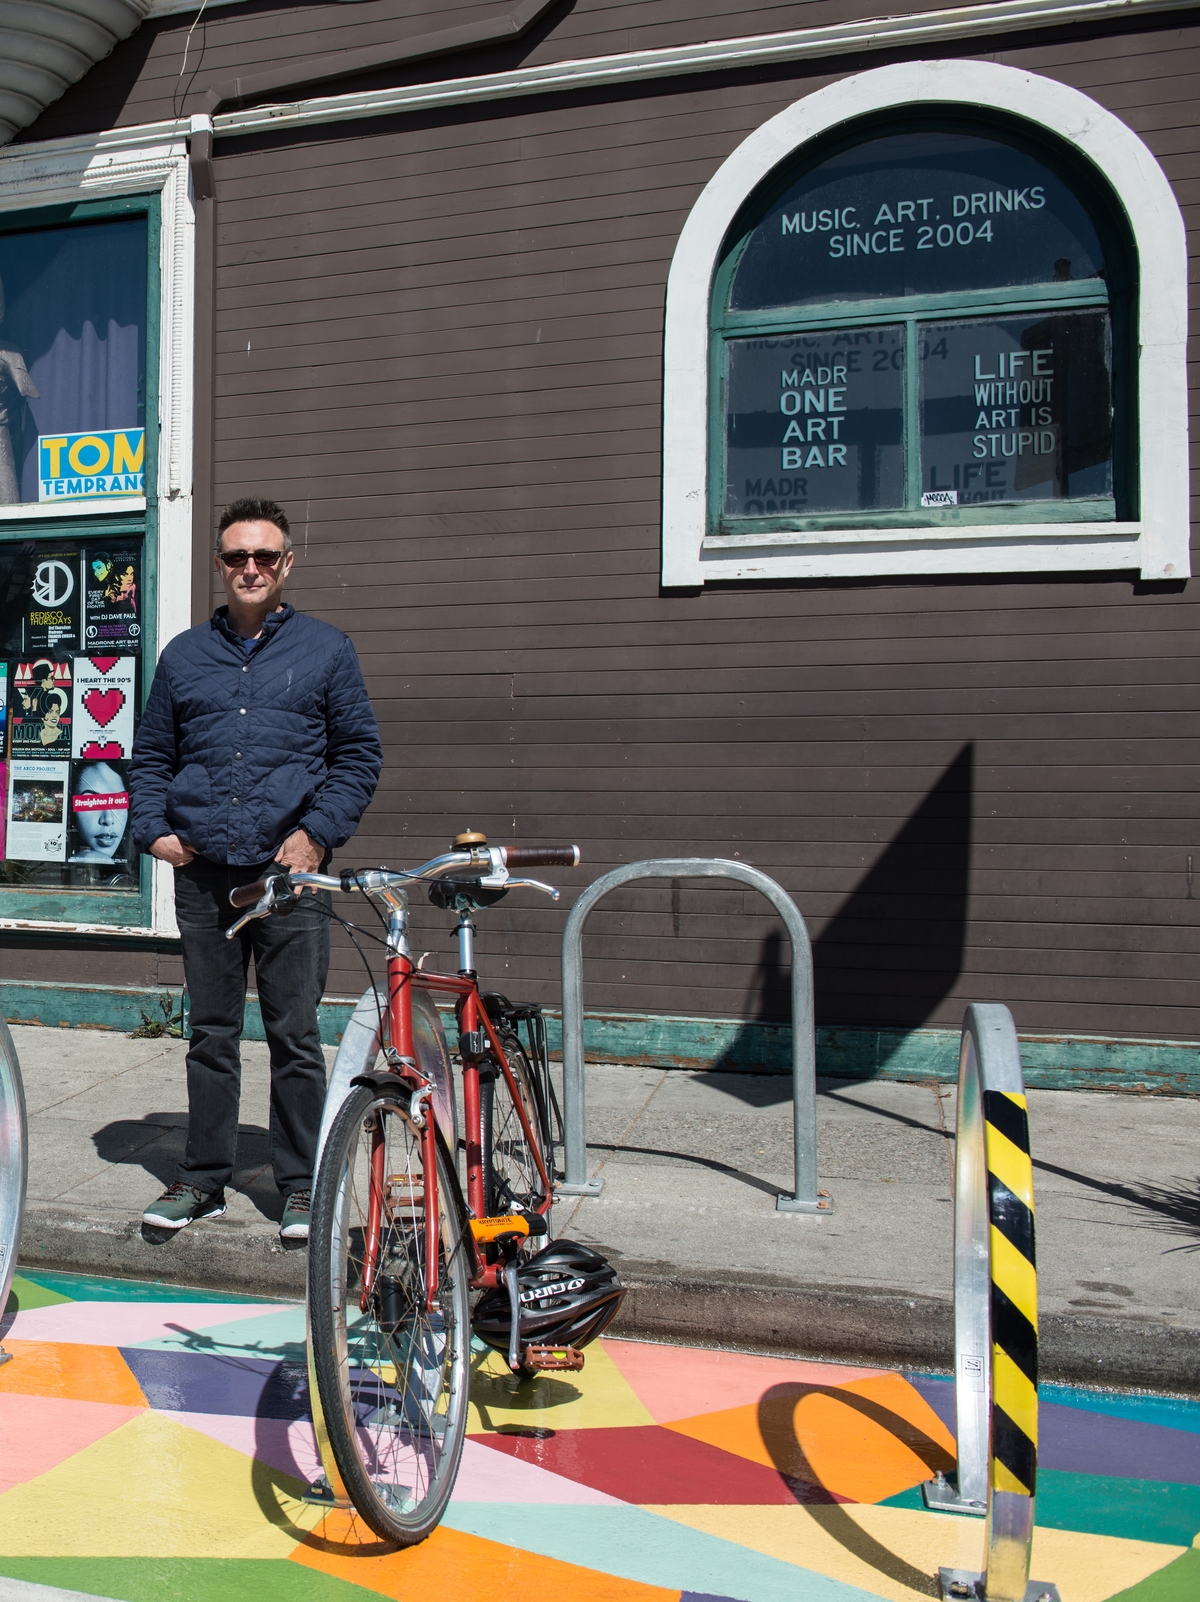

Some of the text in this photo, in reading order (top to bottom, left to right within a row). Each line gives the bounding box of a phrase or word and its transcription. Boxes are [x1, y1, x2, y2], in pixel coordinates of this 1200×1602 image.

[781, 186, 1046, 236] MUSIC, ART, DRINKS
[829, 220, 993, 258] SINCE 2004
[781, 366, 847, 388] MADR
[974, 349, 1054, 380] LIFE
[780, 387, 847, 415] ONE
[974, 379, 1054, 407] WITHOUT
[782, 417, 845, 443] ART
[975, 407, 1052, 429] ART IS
[42, 432, 144, 478] TOM
[781, 444, 847, 470] BAR
[972, 431, 1055, 458] STUPID
[30, 611, 63, 620] REDISCO
[30, 617, 72, 626] THURSDAYS
[74, 797, 107, 807] Straighten
[108, 796, 113, 804] it
[520, 1282, 566, 1303] GIRO
